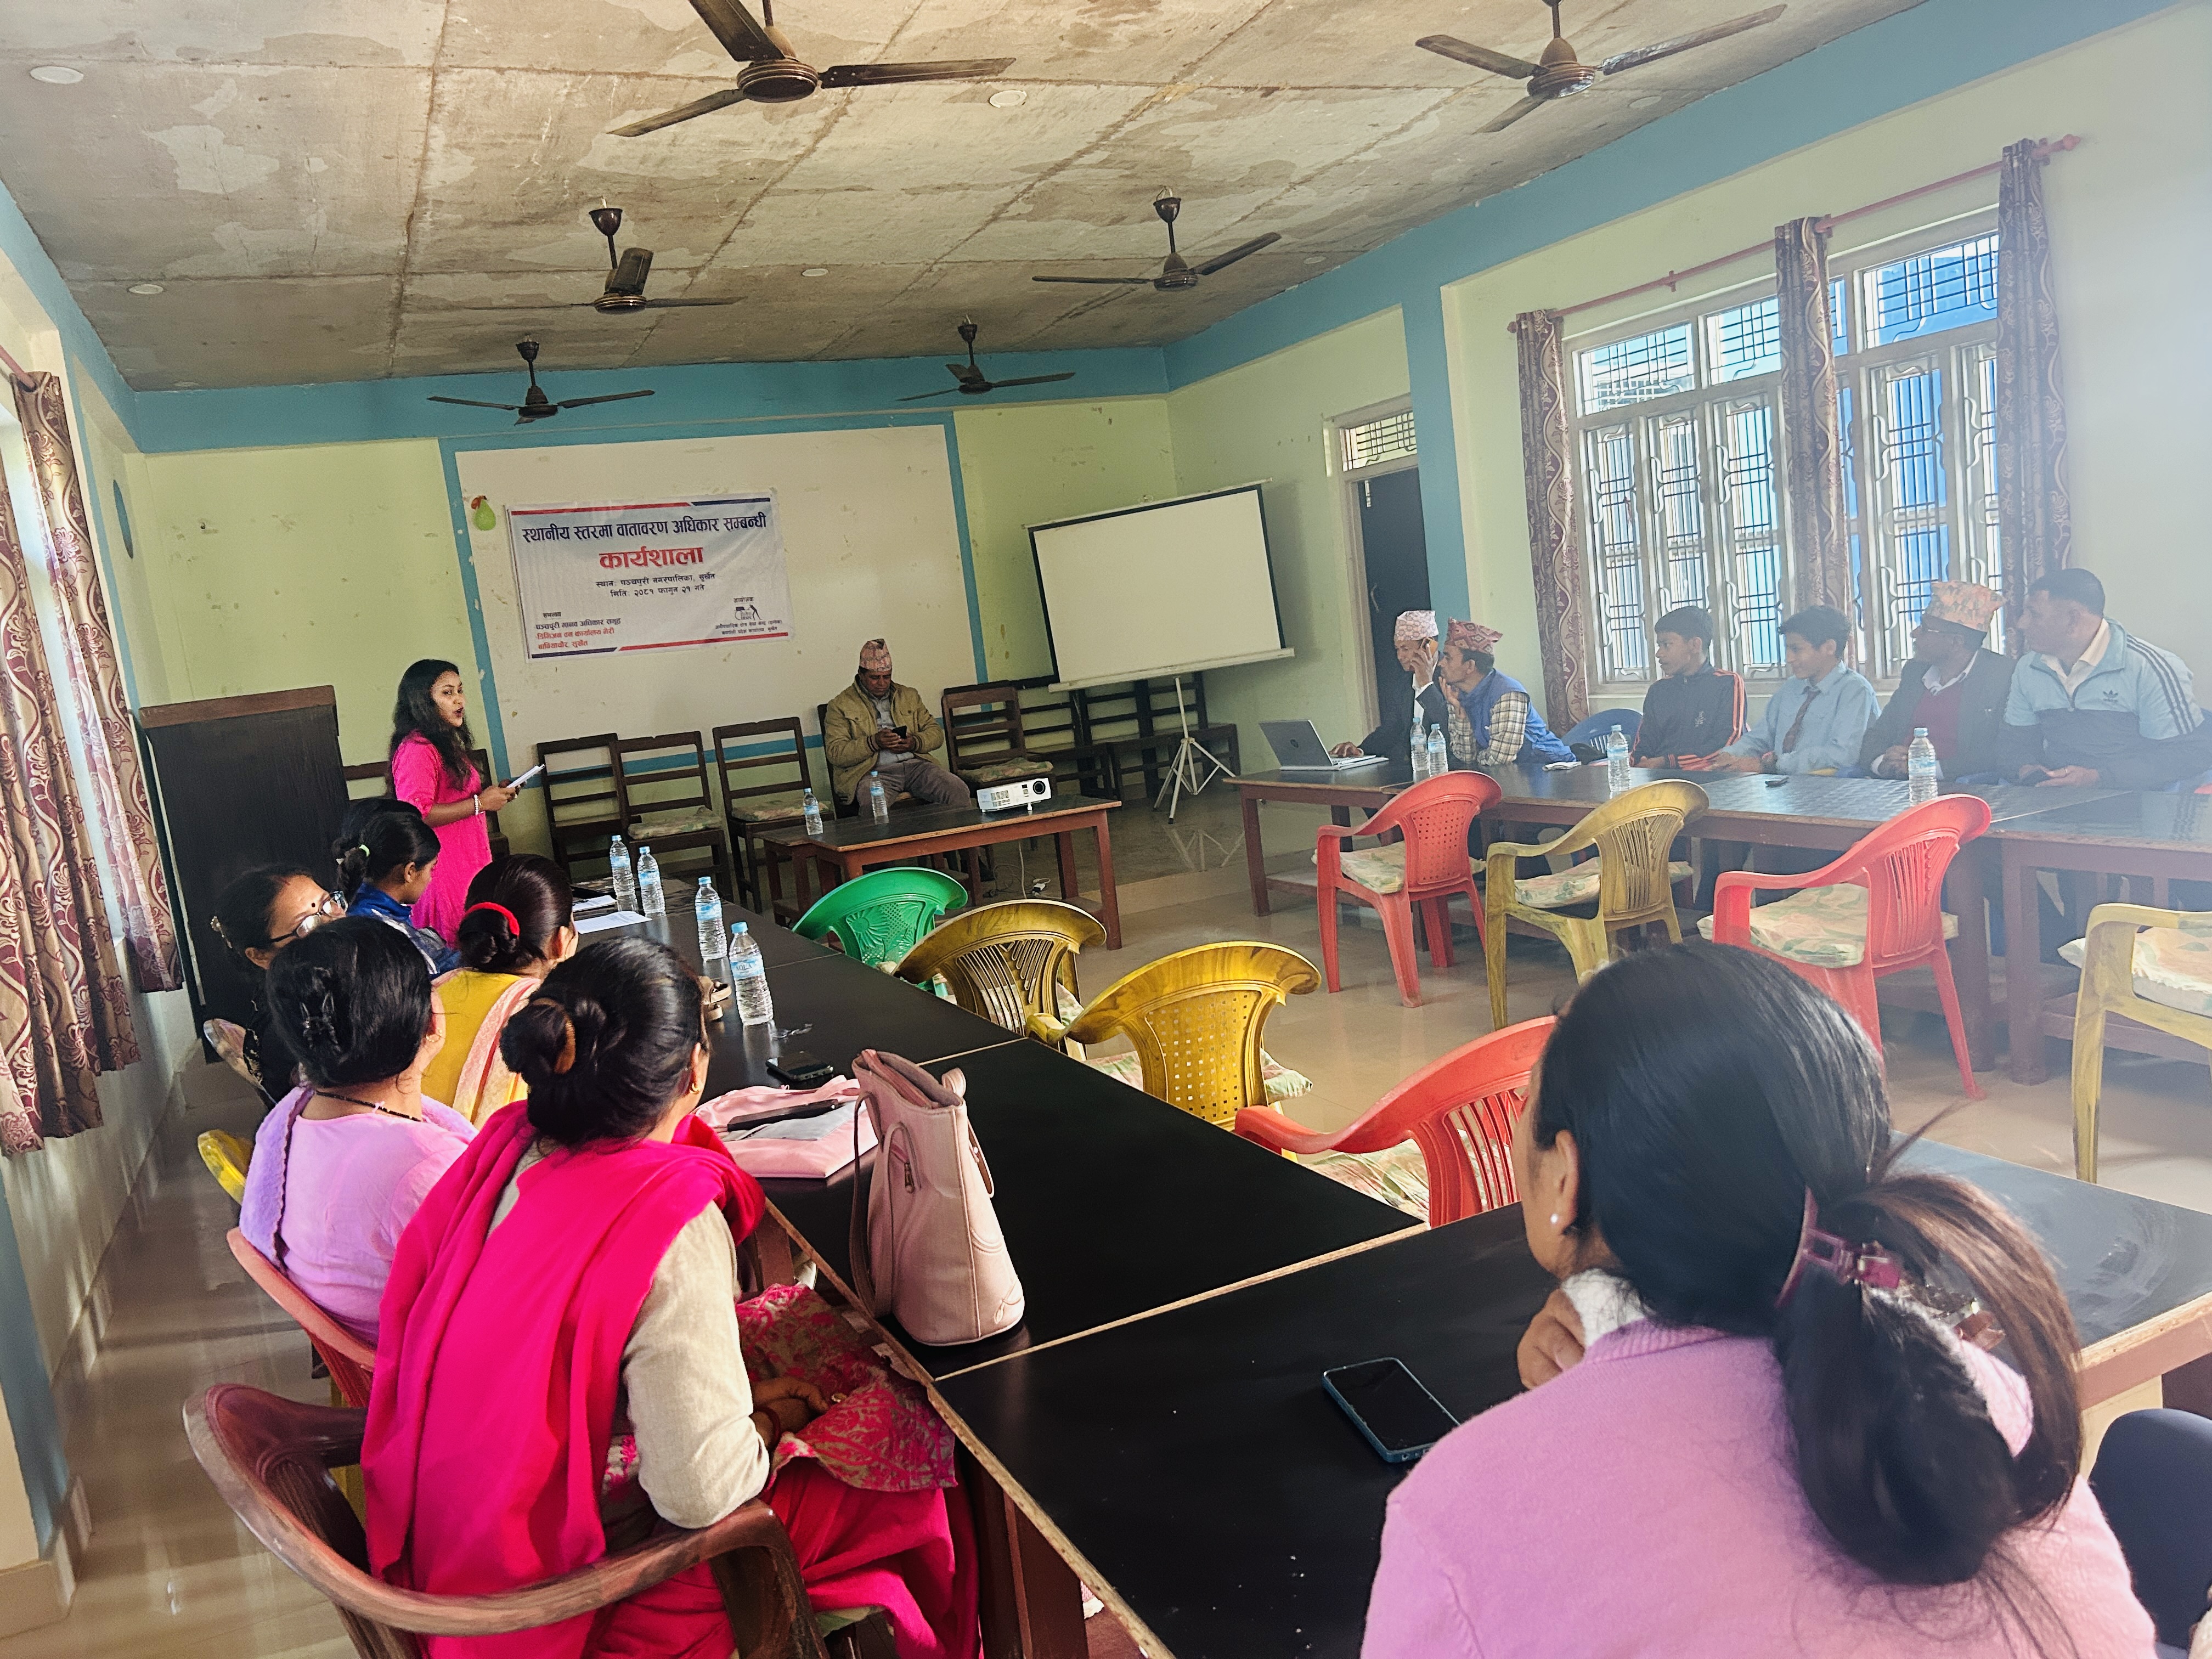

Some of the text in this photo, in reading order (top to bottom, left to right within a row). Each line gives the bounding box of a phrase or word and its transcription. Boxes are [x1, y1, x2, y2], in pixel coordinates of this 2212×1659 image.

[522, 512, 766, 543] स्थानीय स्तरमा वातावरण अधिकार सम्बन्धी
[599, 546, 703, 568] कार्यशाला
[620, 577, 650, 586] पञ्चपुरी
[699, 572, 715, 582] सुर्खेत
[634, 589, 654, 597] २०८१
[658, 586, 678, 595] फागुन
